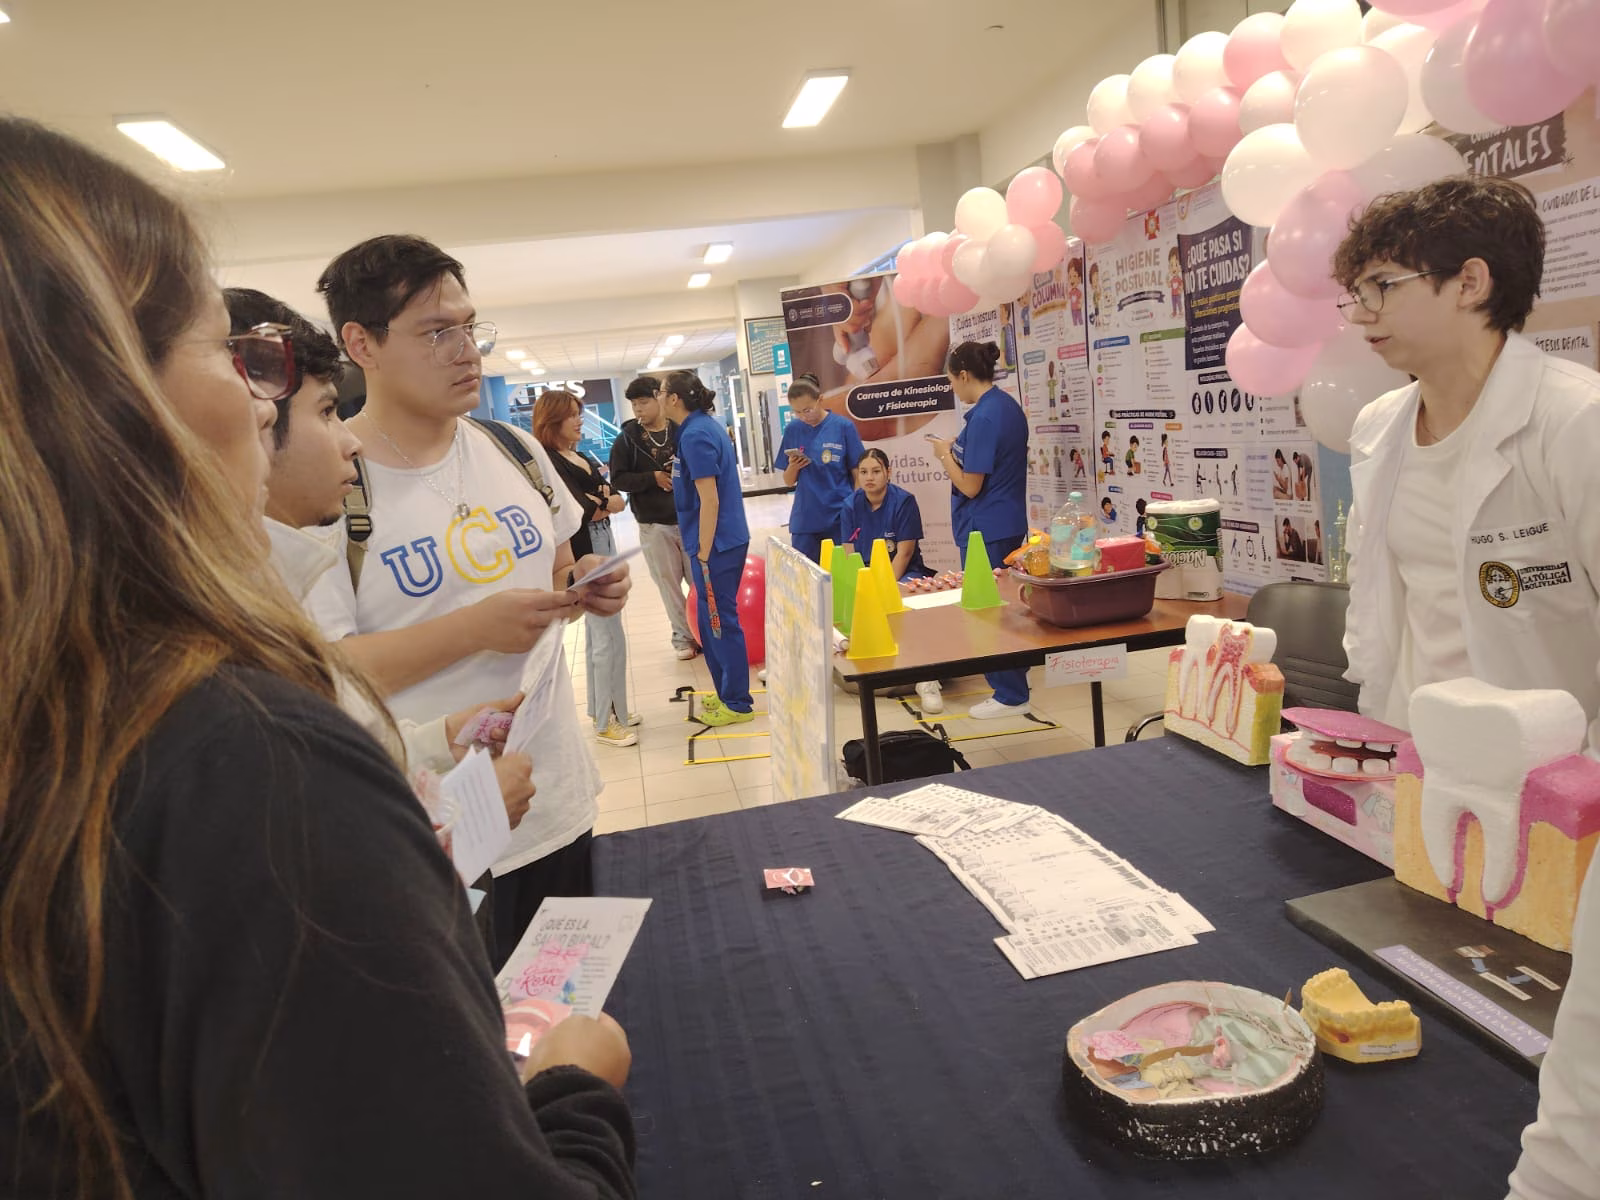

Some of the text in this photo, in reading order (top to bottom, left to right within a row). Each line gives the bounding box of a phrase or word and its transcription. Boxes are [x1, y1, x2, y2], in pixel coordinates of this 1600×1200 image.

[1463, 125, 1552, 176] ENTALES
[1543, 189, 1578, 212] CUIDADOS
[1581, 185, 1592, 202] DE
[1187, 229, 1243, 269] ¿QUÉ PASA SI
[1115, 247, 1160, 276] HIGIENE
[1115, 269, 1164, 296] POSTURAL
[1185, 253, 1250, 295] NO TE CUIDAS?
[1032, 281, 1066, 309] COLUMNA
[1562, 335, 1590, 351] DENTAL
[857, 383, 952, 401] Carrera de Kinesiologí
[878, 398, 938, 413] y Fisioterapia
[896, 470, 950, 484] futuros
[1471, 534, 1494, 545] HUGO
[1513, 522, 1550, 539] LEIGUE
[380, 505, 542, 597] UCB
[1163, 549, 1207, 568] Nacio
[1520, 562, 1566, 574] UNIVERSIDAD
[1522, 570, 1568, 584] CATÓLICA
[1523, 578, 1569, 591] BOLIVIANA
[1049, 655, 1119, 671] Fisioterapia
